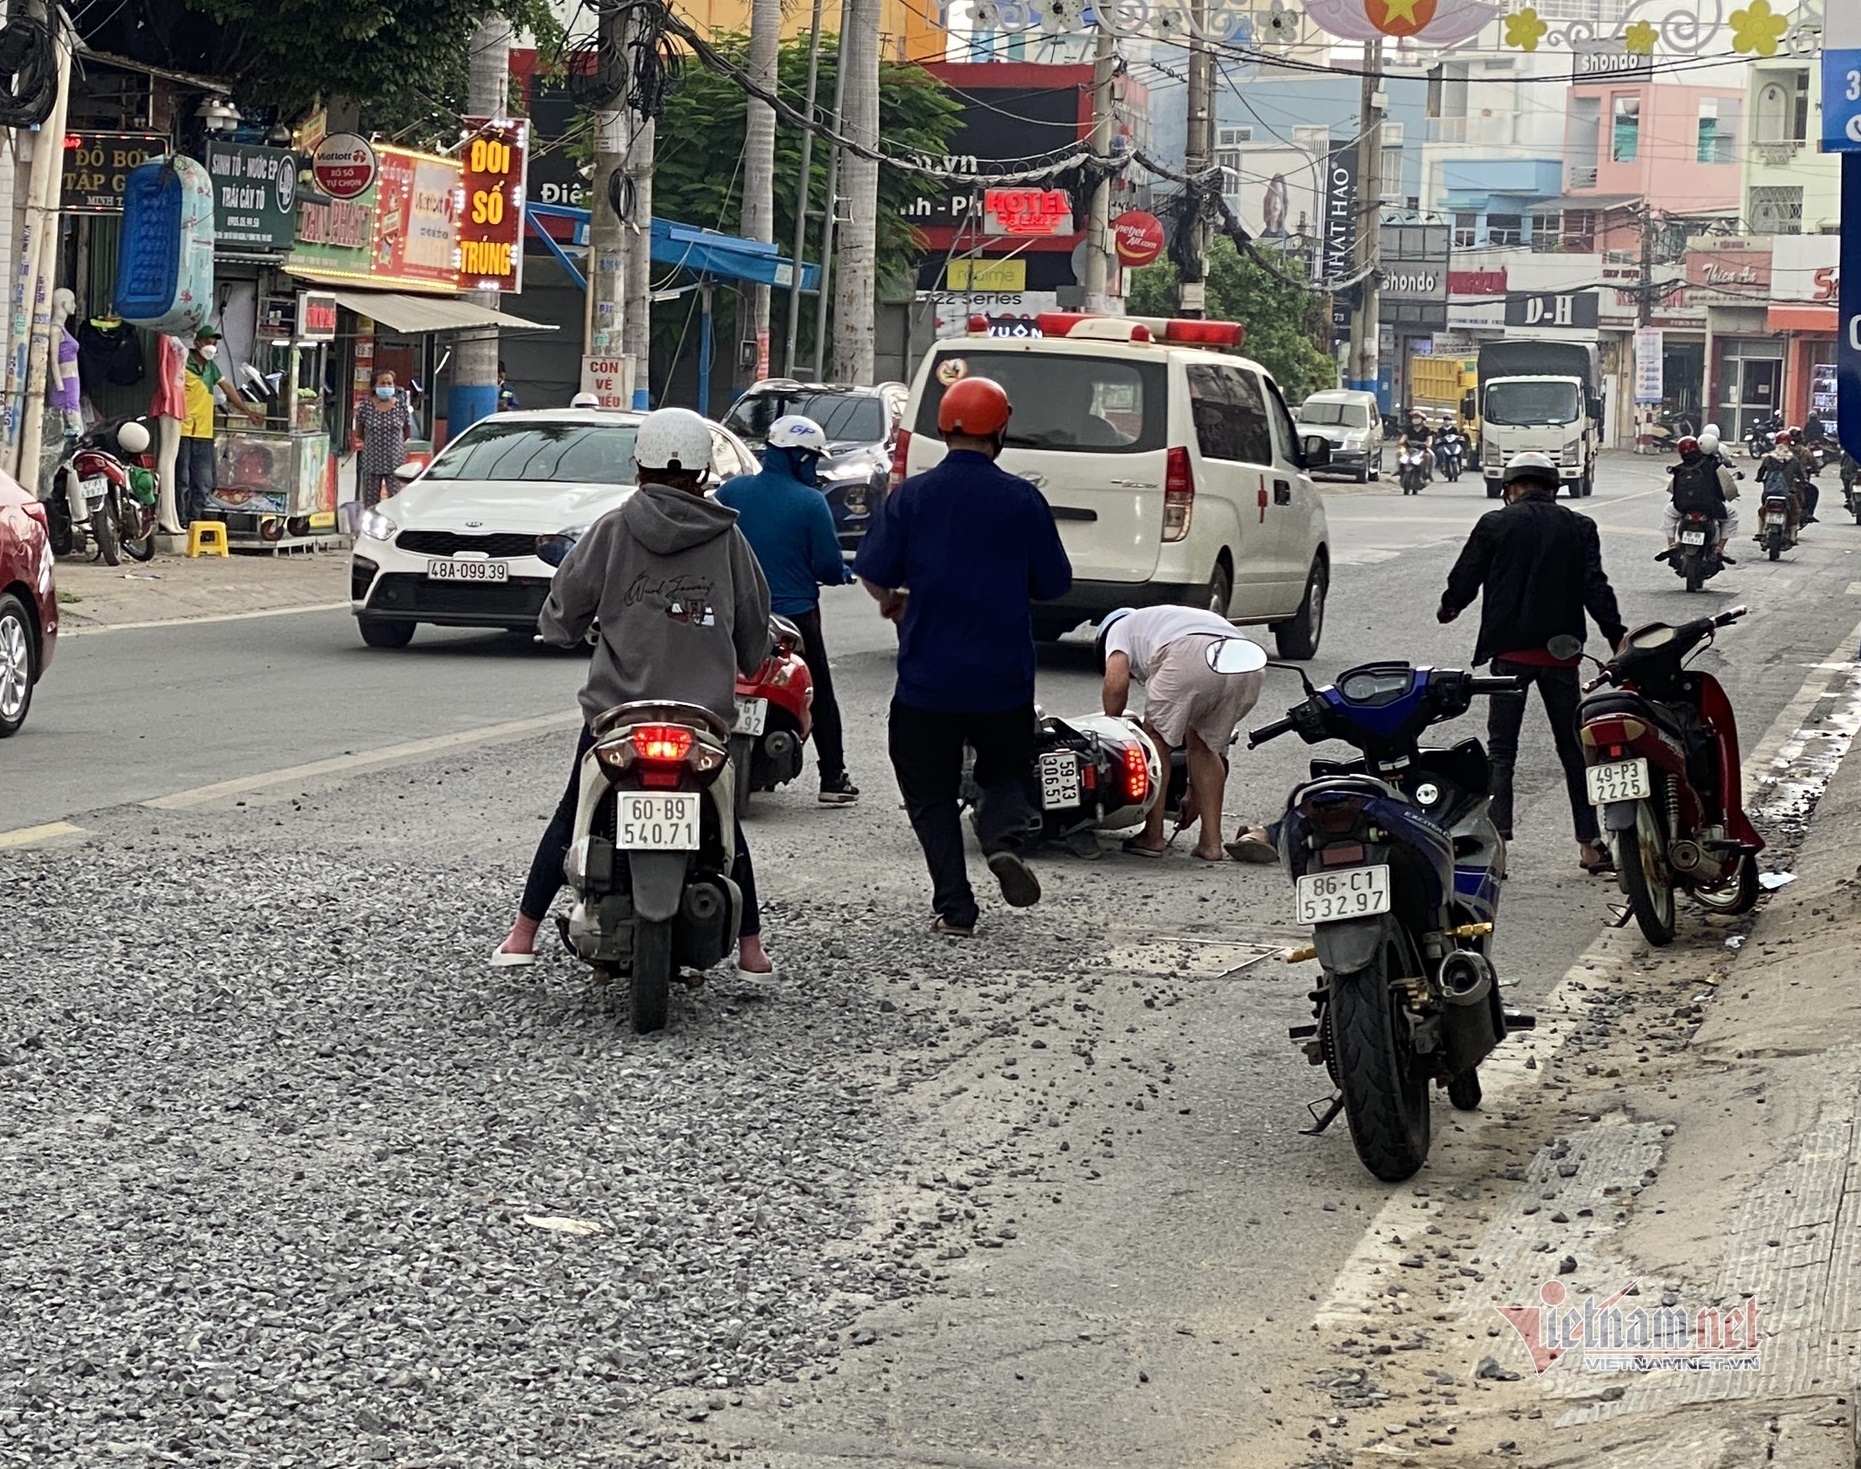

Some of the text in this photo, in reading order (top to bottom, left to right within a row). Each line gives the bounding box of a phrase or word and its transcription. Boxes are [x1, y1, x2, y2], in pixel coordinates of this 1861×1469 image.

[317, 152, 352, 160] Vietlott
[268, 155, 278, 180] ÉP
[63, 169, 105, 194] TẬP
[338, 179, 361, 188] CHỌN
[472, 180, 505, 225] SỐ
[986, 191, 1072, 213] HOTEL
[461, 235, 511, 276] TRÚNG
[590, 359, 618, 373] CÒN
[431, 562, 505, 580] 48A-099.39
[1043, 758, 1061, 805] 306.51
[1060, 760, 1077, 800] 59-X3
[1596, 763, 1639, 784] 49-P3
[1597, 780, 1640, 801] 2225
[632, 800, 685, 820] 60-B9
[625, 823, 692, 845] 540.71
[1313, 871, 1374, 897] 86-C1
[1305, 890, 1384, 920] 532.97
